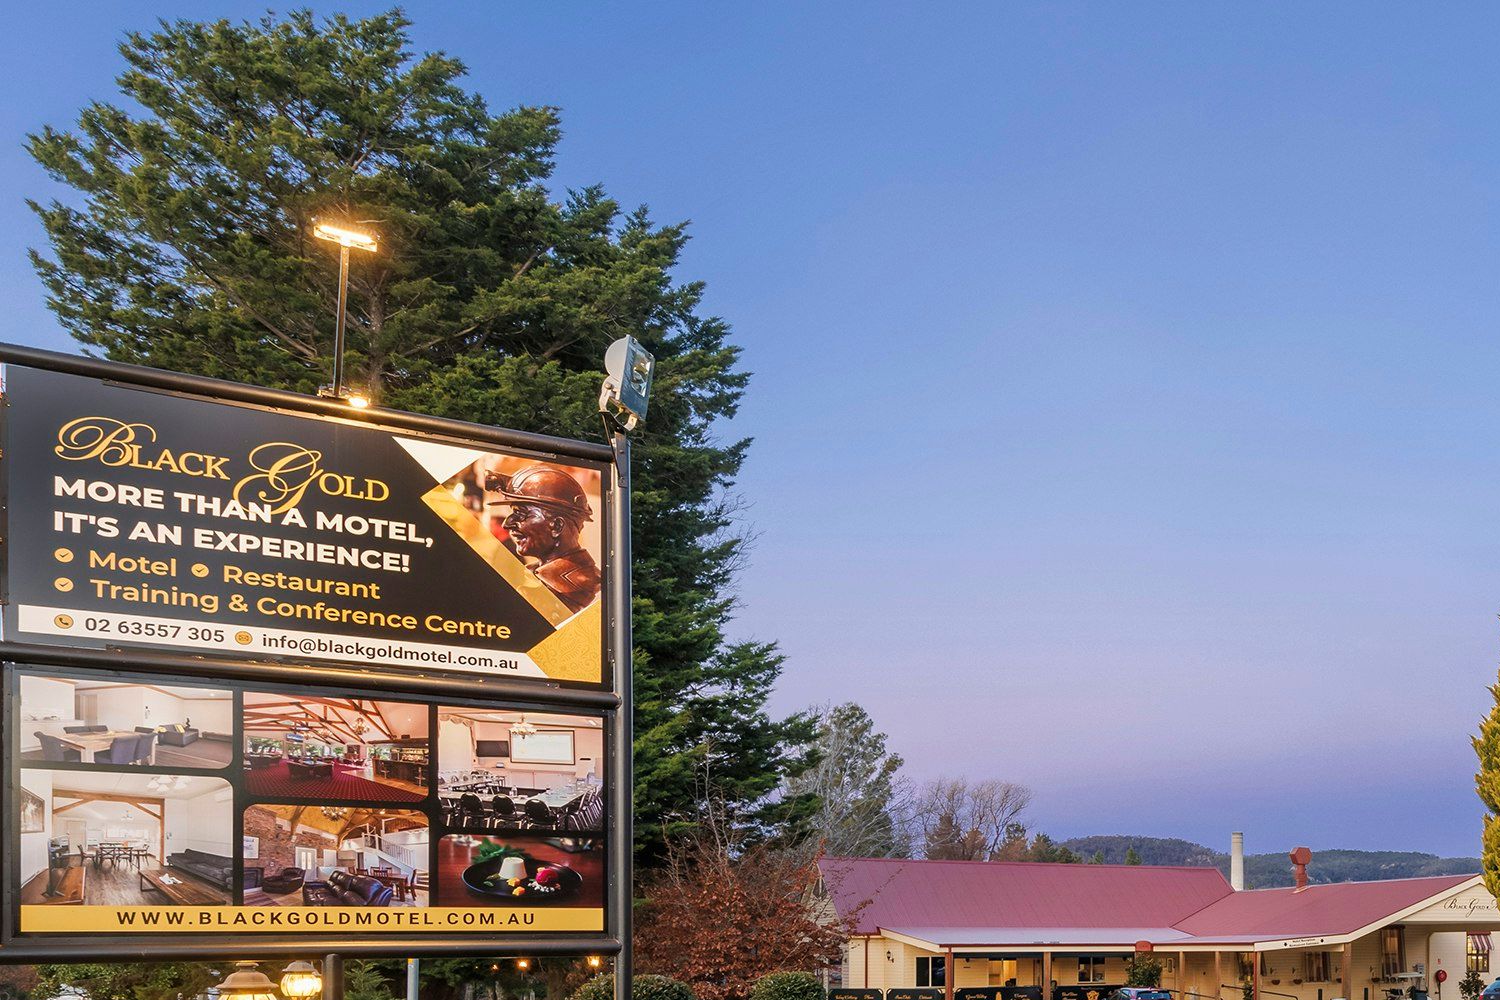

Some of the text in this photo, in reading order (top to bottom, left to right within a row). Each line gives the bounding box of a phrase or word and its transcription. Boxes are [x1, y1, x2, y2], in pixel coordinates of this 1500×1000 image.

[54, 416, 390, 515] BLACK GOLD
[54, 476, 434, 548] MORE THAN A MOTEL,
[54, 511, 411, 573] IT'S AN EXPERIENCE!
[89, 550, 381, 600] Motel Restaurant
[85, 617, 225, 643] 02 63557 305
[89, 578, 512, 639] Training & Conference Centre
[262, 633, 519, 670] info@blackgoldmotel.com.au
[116, 911, 536, 926] WWW.BLACKGOLDMOTEL.COM.AU
